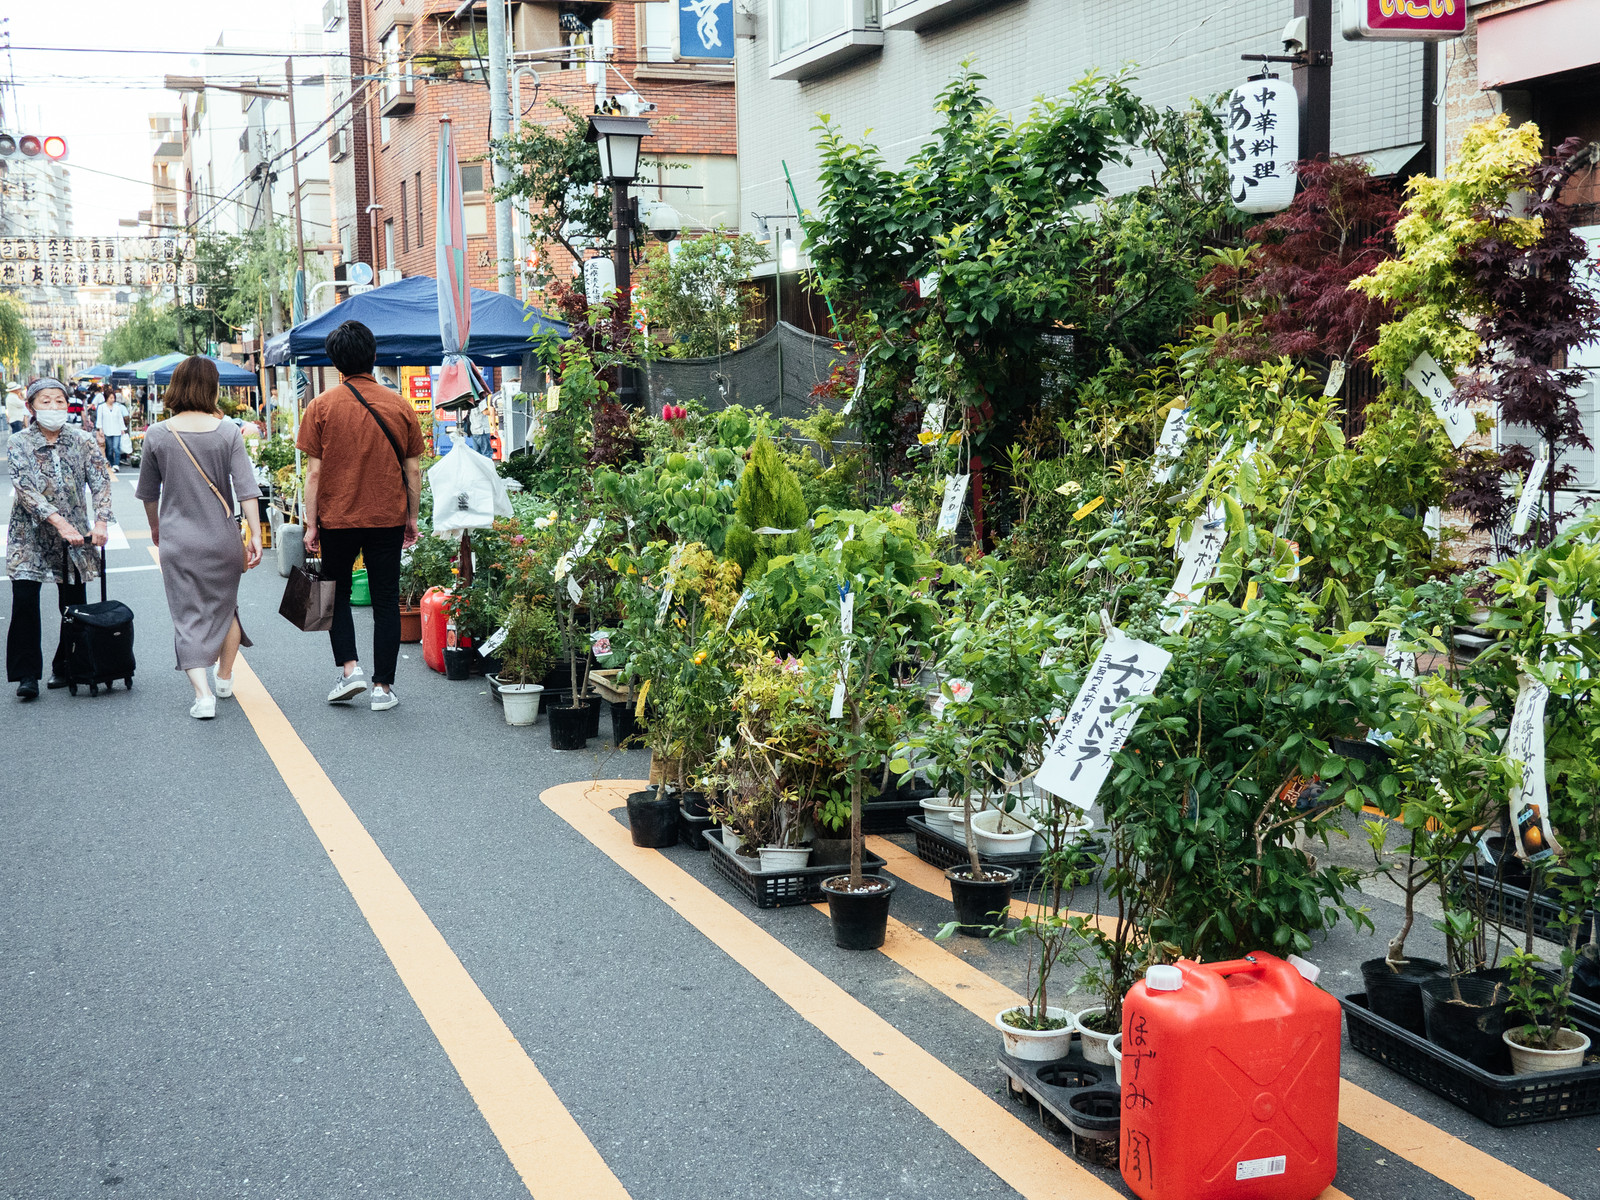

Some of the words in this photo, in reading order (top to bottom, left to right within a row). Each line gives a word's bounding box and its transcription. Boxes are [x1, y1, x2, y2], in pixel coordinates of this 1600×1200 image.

[1229, 89, 1259, 203] あさひ
[1249, 87, 1280, 179] 中華料理
[1069, 654, 1145, 781] チャンドラー
